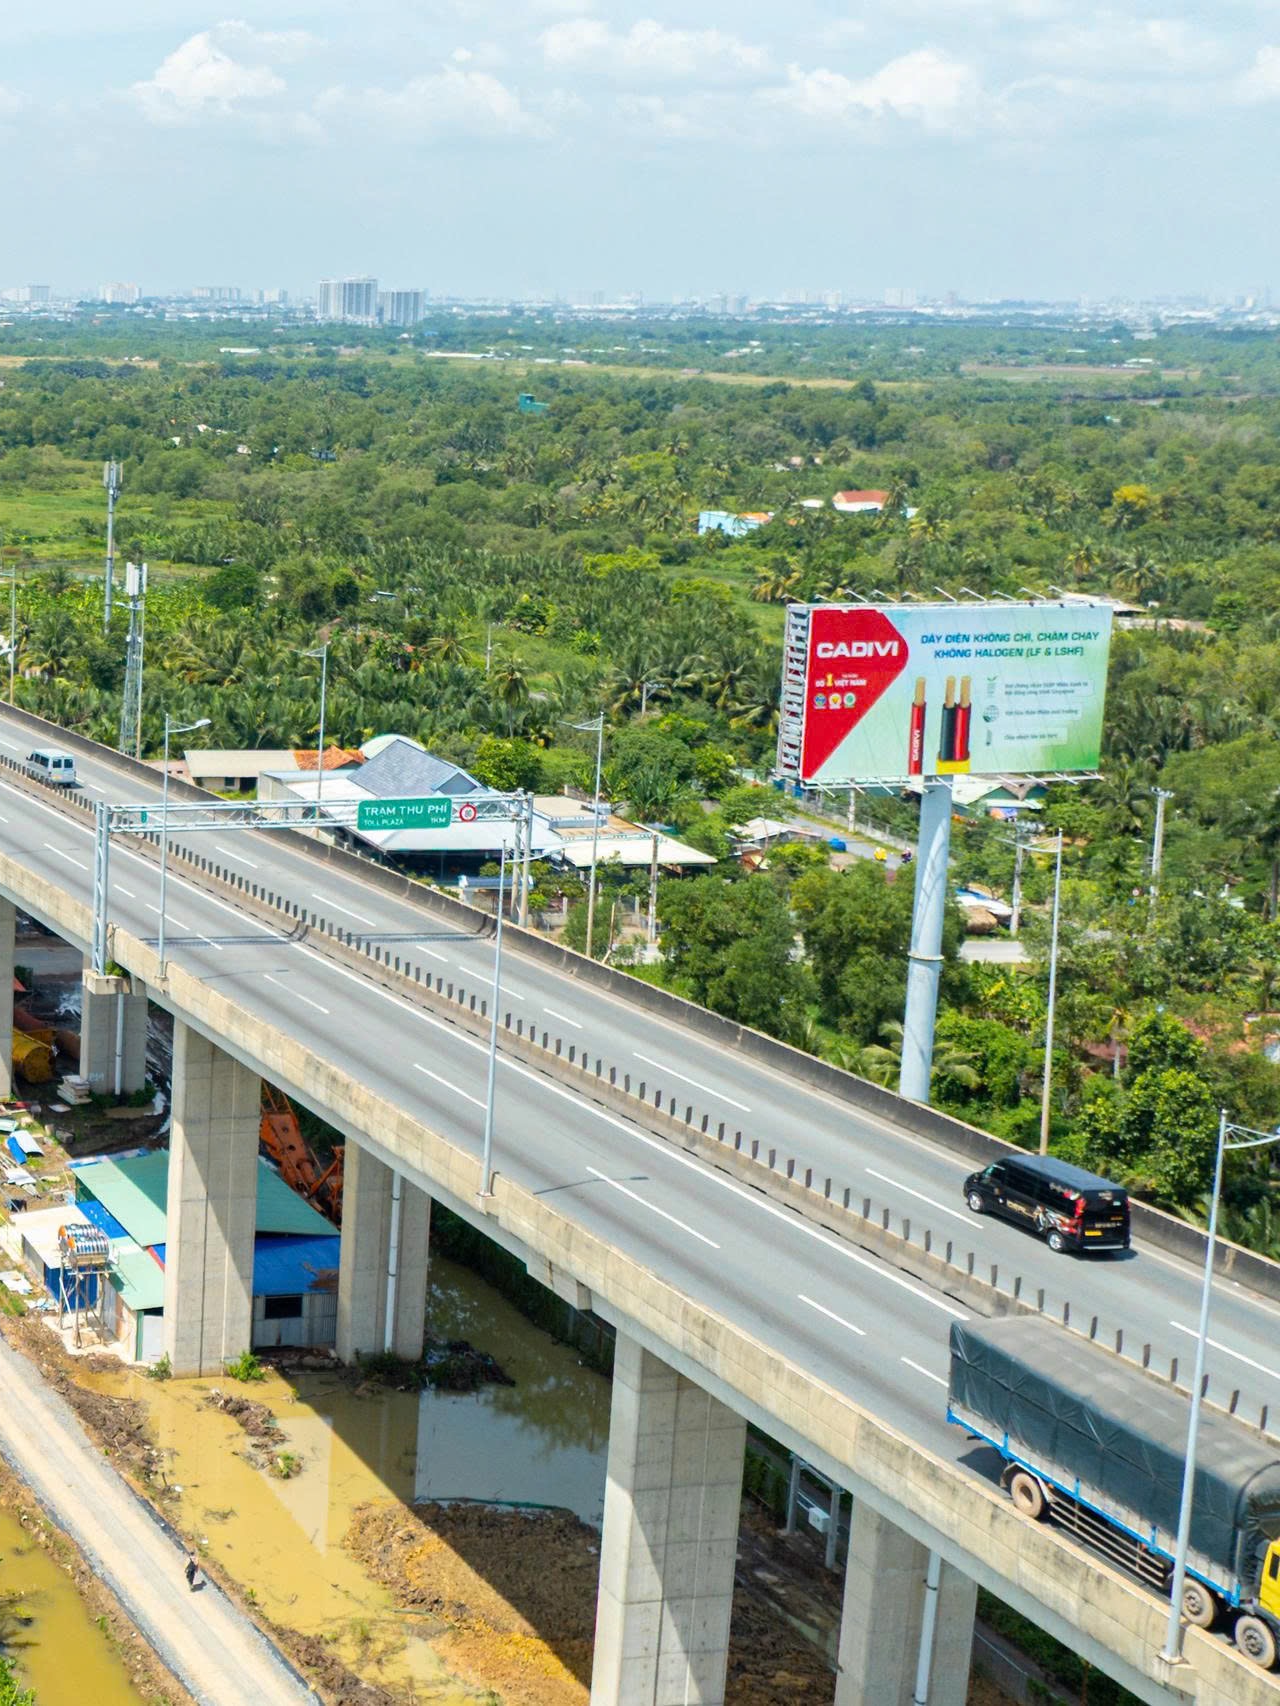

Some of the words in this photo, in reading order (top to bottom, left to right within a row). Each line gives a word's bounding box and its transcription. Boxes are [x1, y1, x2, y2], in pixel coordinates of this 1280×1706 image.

[973, 631, 1010, 643] KHÔNG
[816, 641, 899, 658] CADIVI
[934, 647, 971, 658] KHÔNG
[974, 647, 1023, 657] HALOGEN
[912, 729, 921, 762] CADIVI
[399, 805, 424, 815] THU
[427, 802, 448, 814] PHÍ
[363, 818, 381, 826] TOLL
[381, 818, 405, 826] PLAZA
